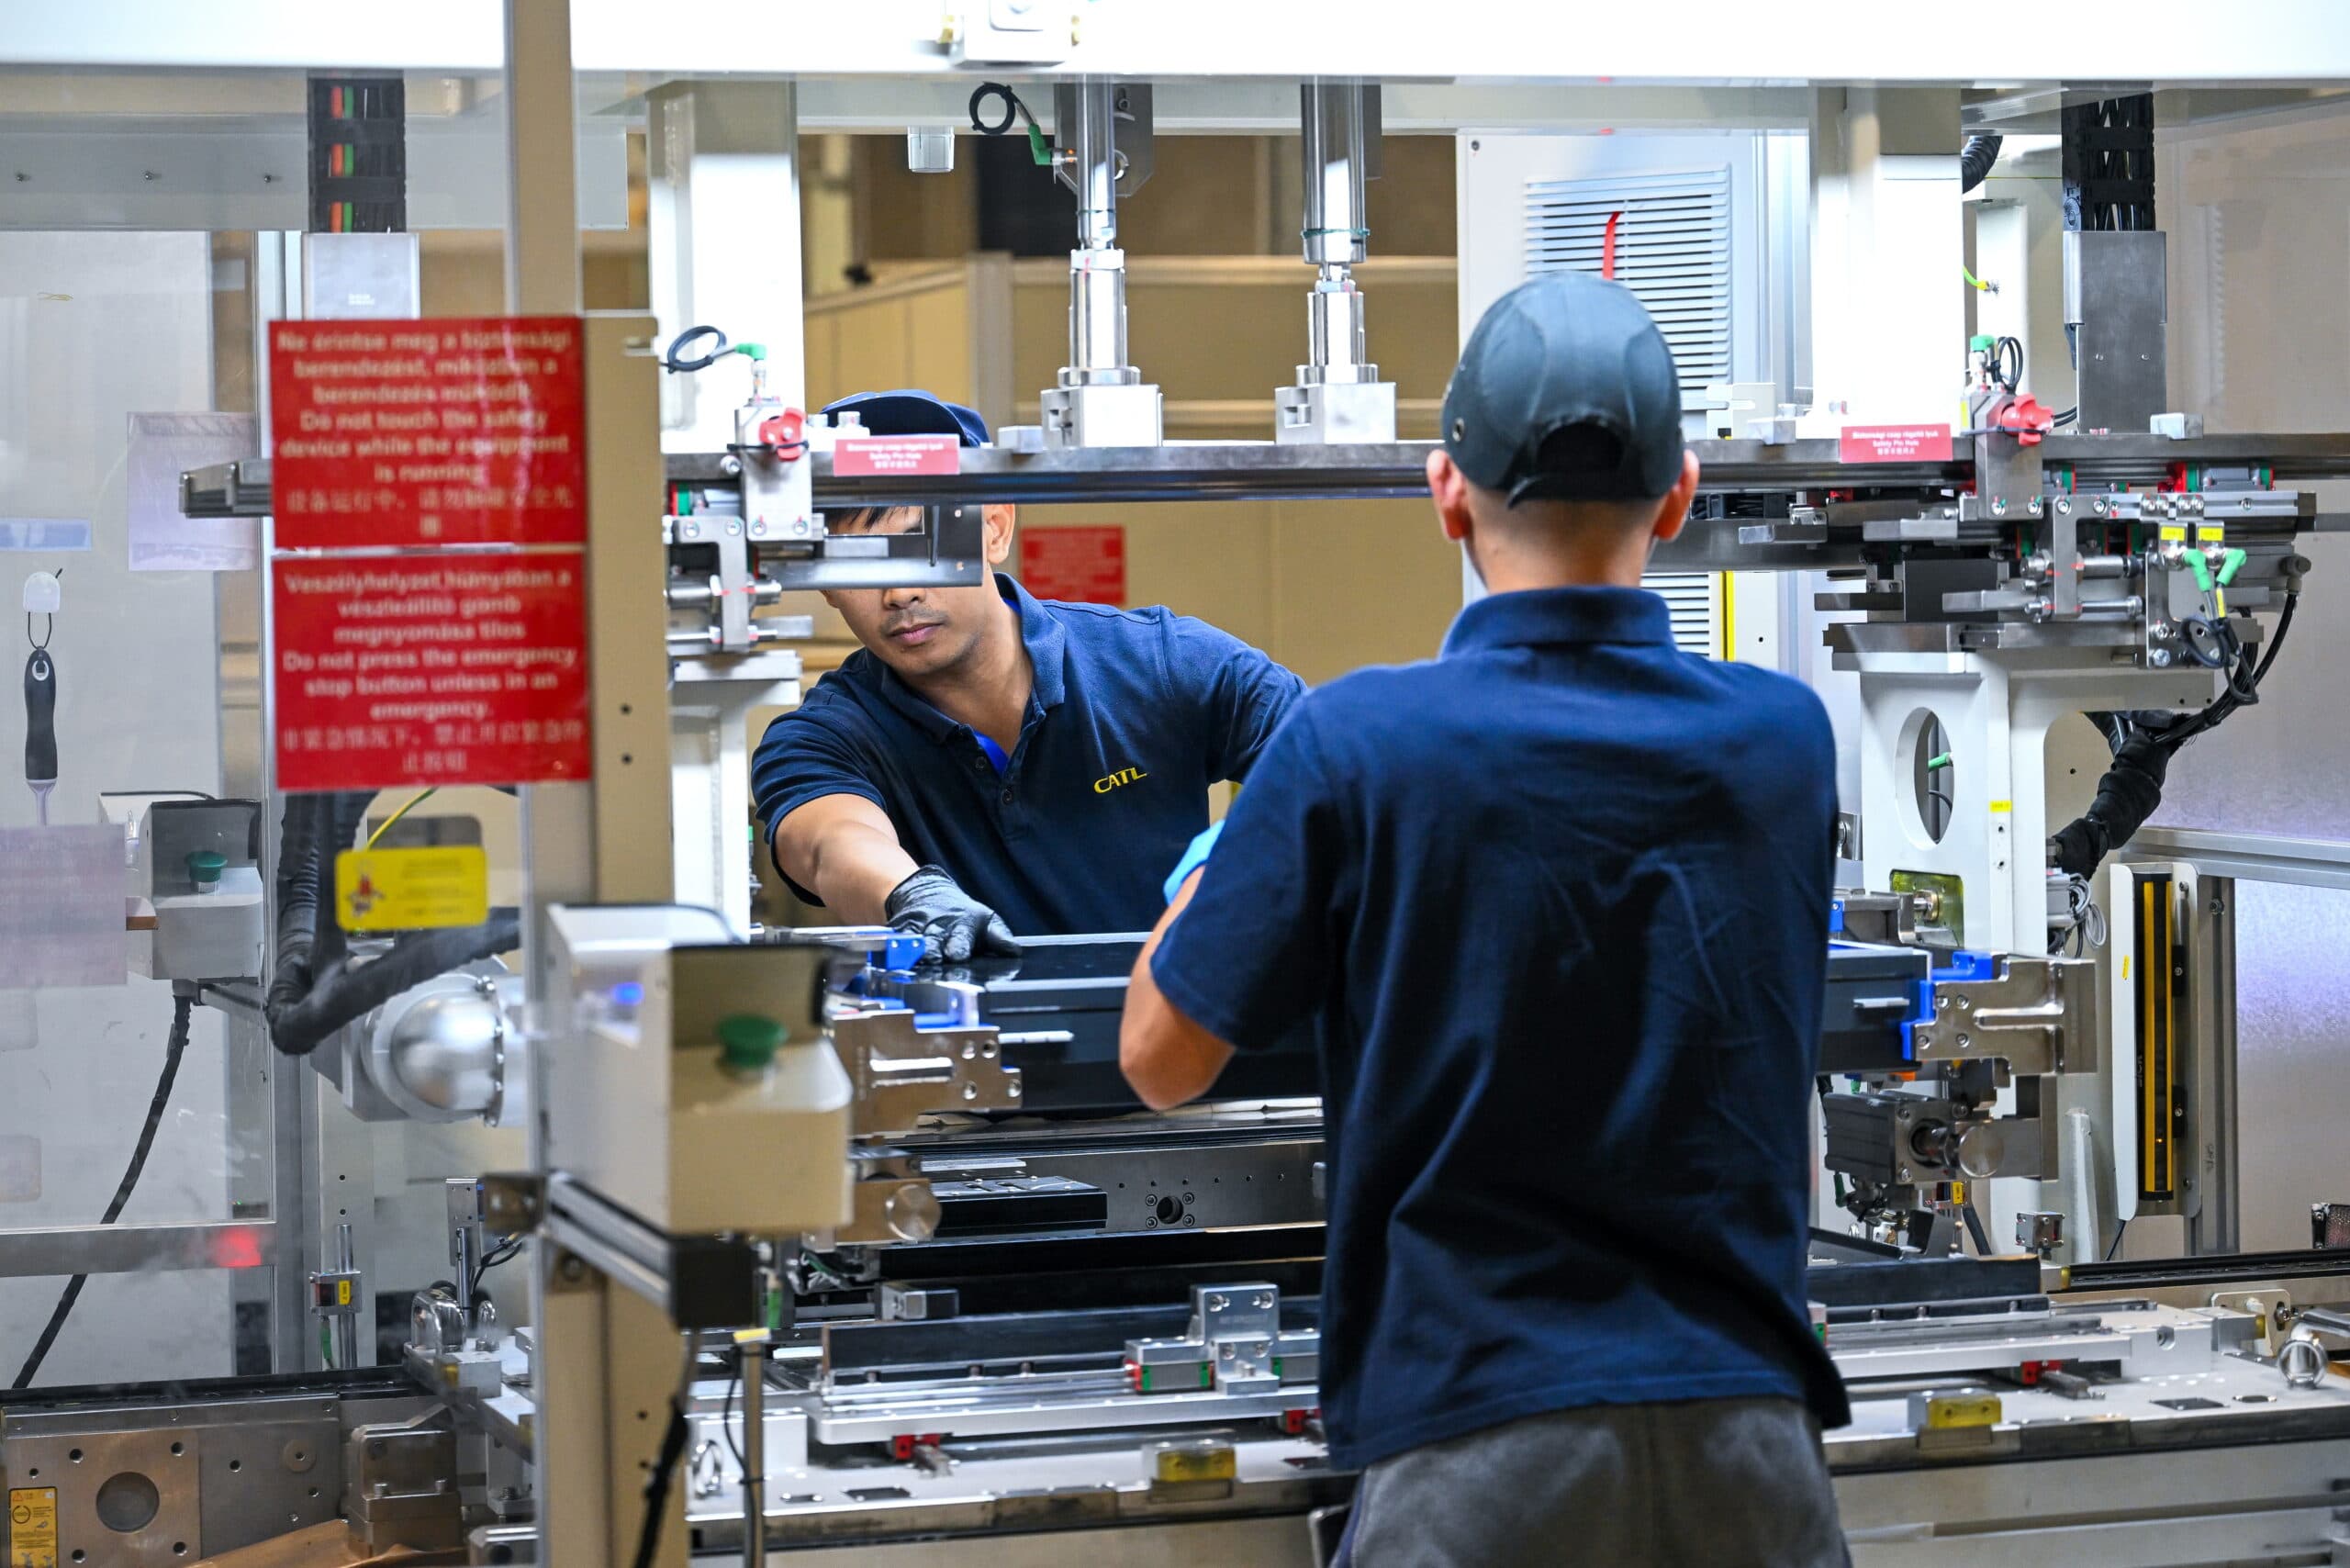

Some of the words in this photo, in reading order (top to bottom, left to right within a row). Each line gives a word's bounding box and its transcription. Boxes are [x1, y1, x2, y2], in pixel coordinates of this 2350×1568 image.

[277, 330, 308, 352] Ne
[391, 333, 439, 354] meg
[442, 333, 457, 349] a
[543, 358, 558, 375] a
[312, 383, 436, 403] berendezés
[300, 410, 332, 431] Do
[336, 411, 373, 430] not
[376, 409, 440, 430] touch
[442, 409, 478, 428] the
[482, 409, 548, 431] safety
[279, 436, 351, 457] device
[355, 435, 412, 455] while
[416, 435, 453, 455] the
[455, 435, 569, 457] equipment
[375, 464, 394, 481] is
[556, 570, 572, 587] a
[459, 594, 520, 619] gomb
[283, 650, 315, 672] Do
[318, 650, 353, 670] not
[357, 651, 419, 672] press
[421, 647, 457, 667] the
[461, 646, 577, 669] emergency
[304, 678, 352, 700] stop
[355, 675, 427, 695] button
[431, 672, 501, 693] unless
[505, 671, 527, 689] in
[530, 672, 558, 689] an
[1093, 767, 1147, 794] CATL
